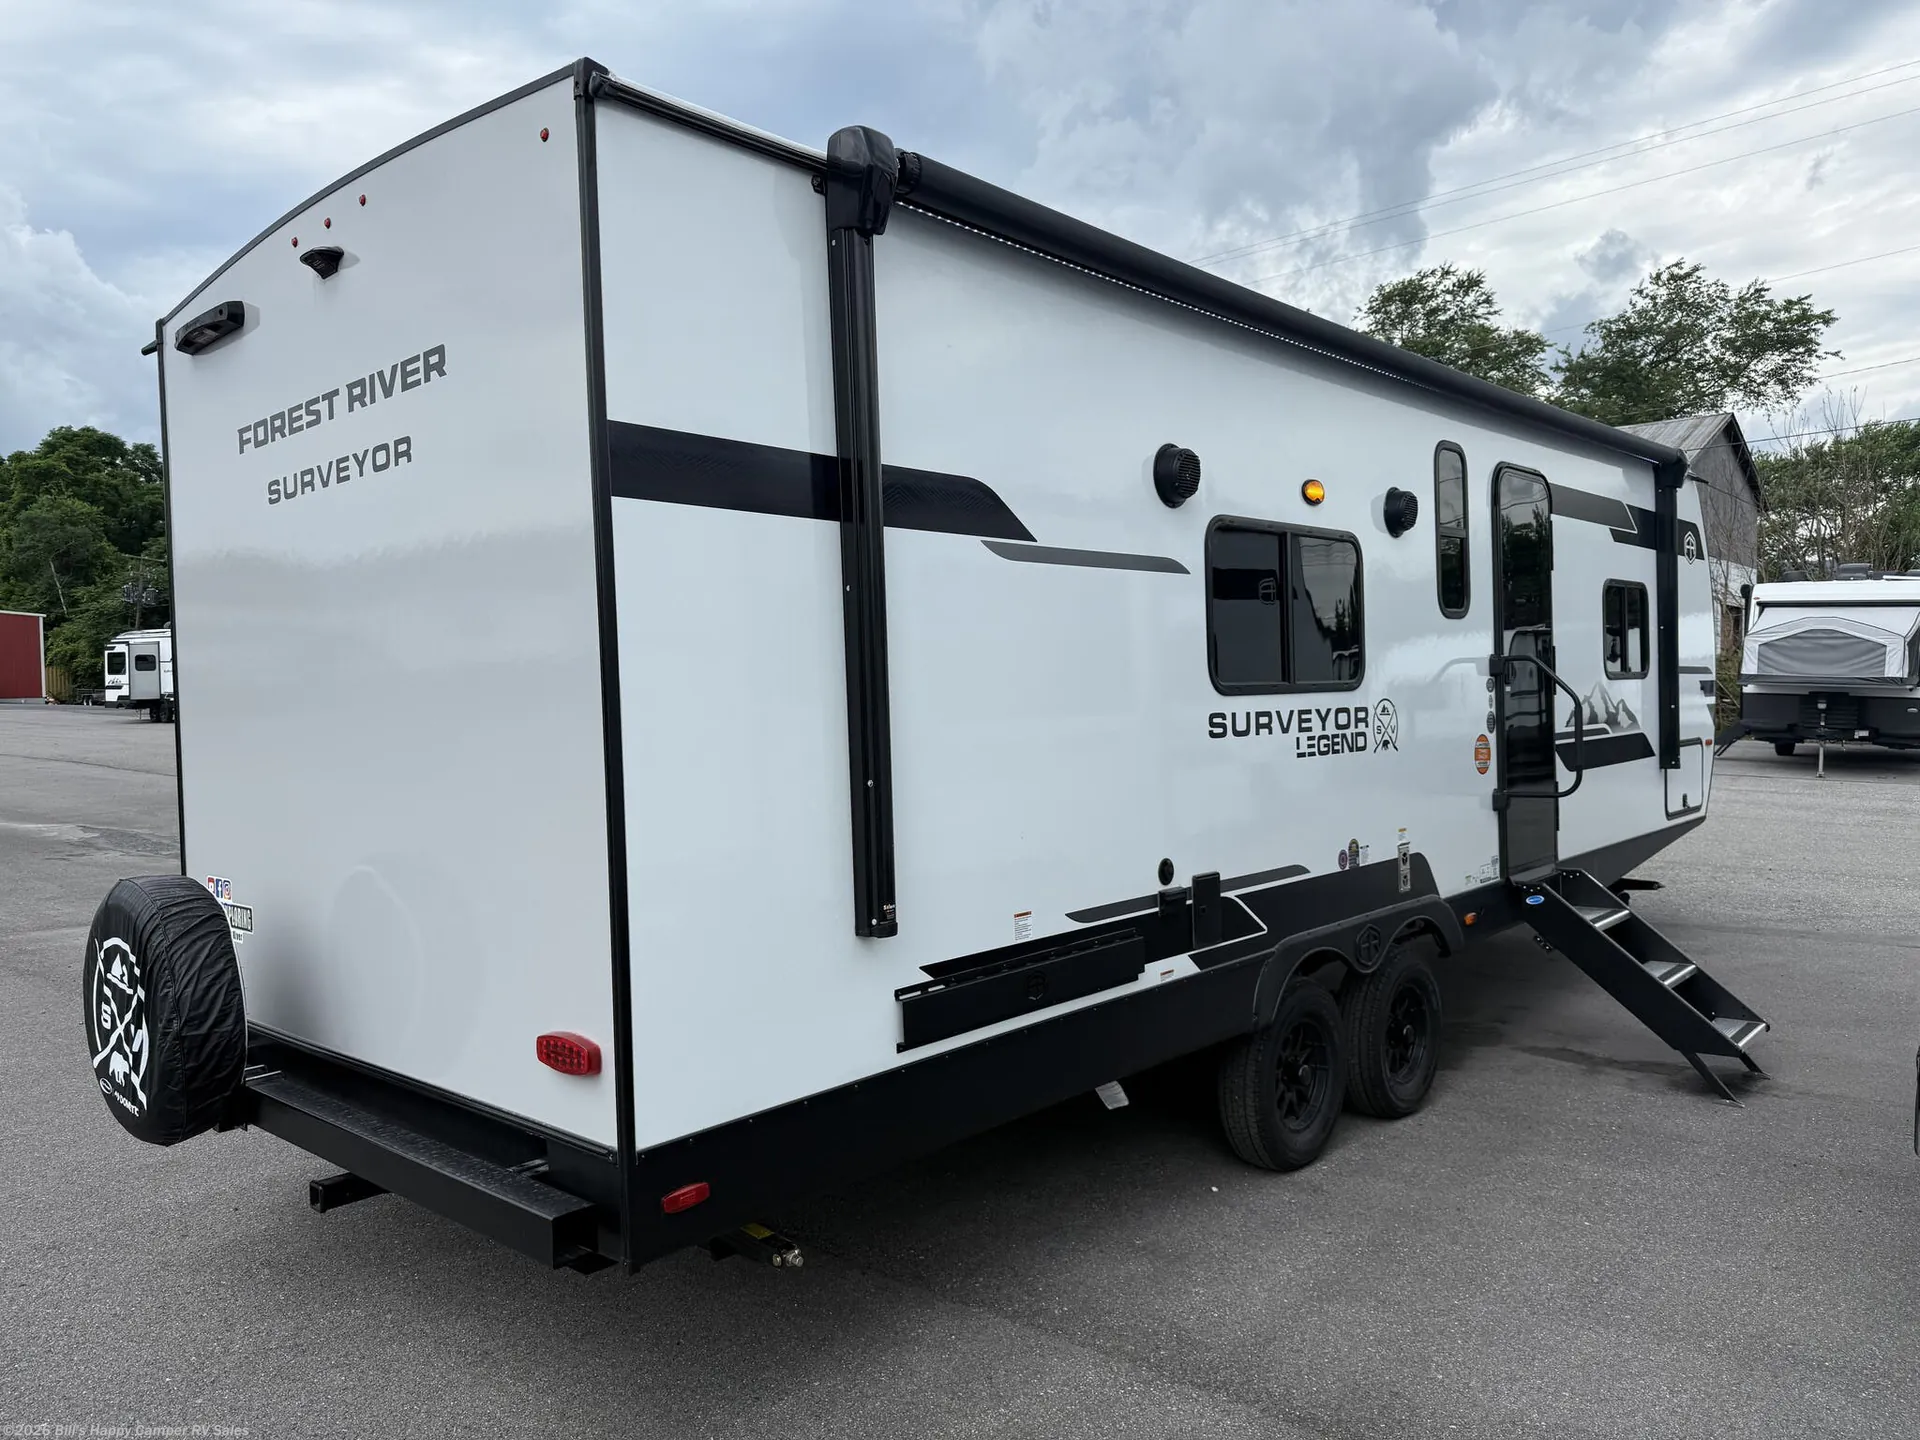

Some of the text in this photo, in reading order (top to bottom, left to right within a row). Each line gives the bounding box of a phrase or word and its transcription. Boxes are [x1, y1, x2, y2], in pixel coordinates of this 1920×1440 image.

[237, 343, 448, 455] FOREST RIVER
[267, 435, 413, 506] SURVEYOR
[1208, 706, 1369, 739] SURVEYOR
[1295, 731, 1368, 758] LEGEND
